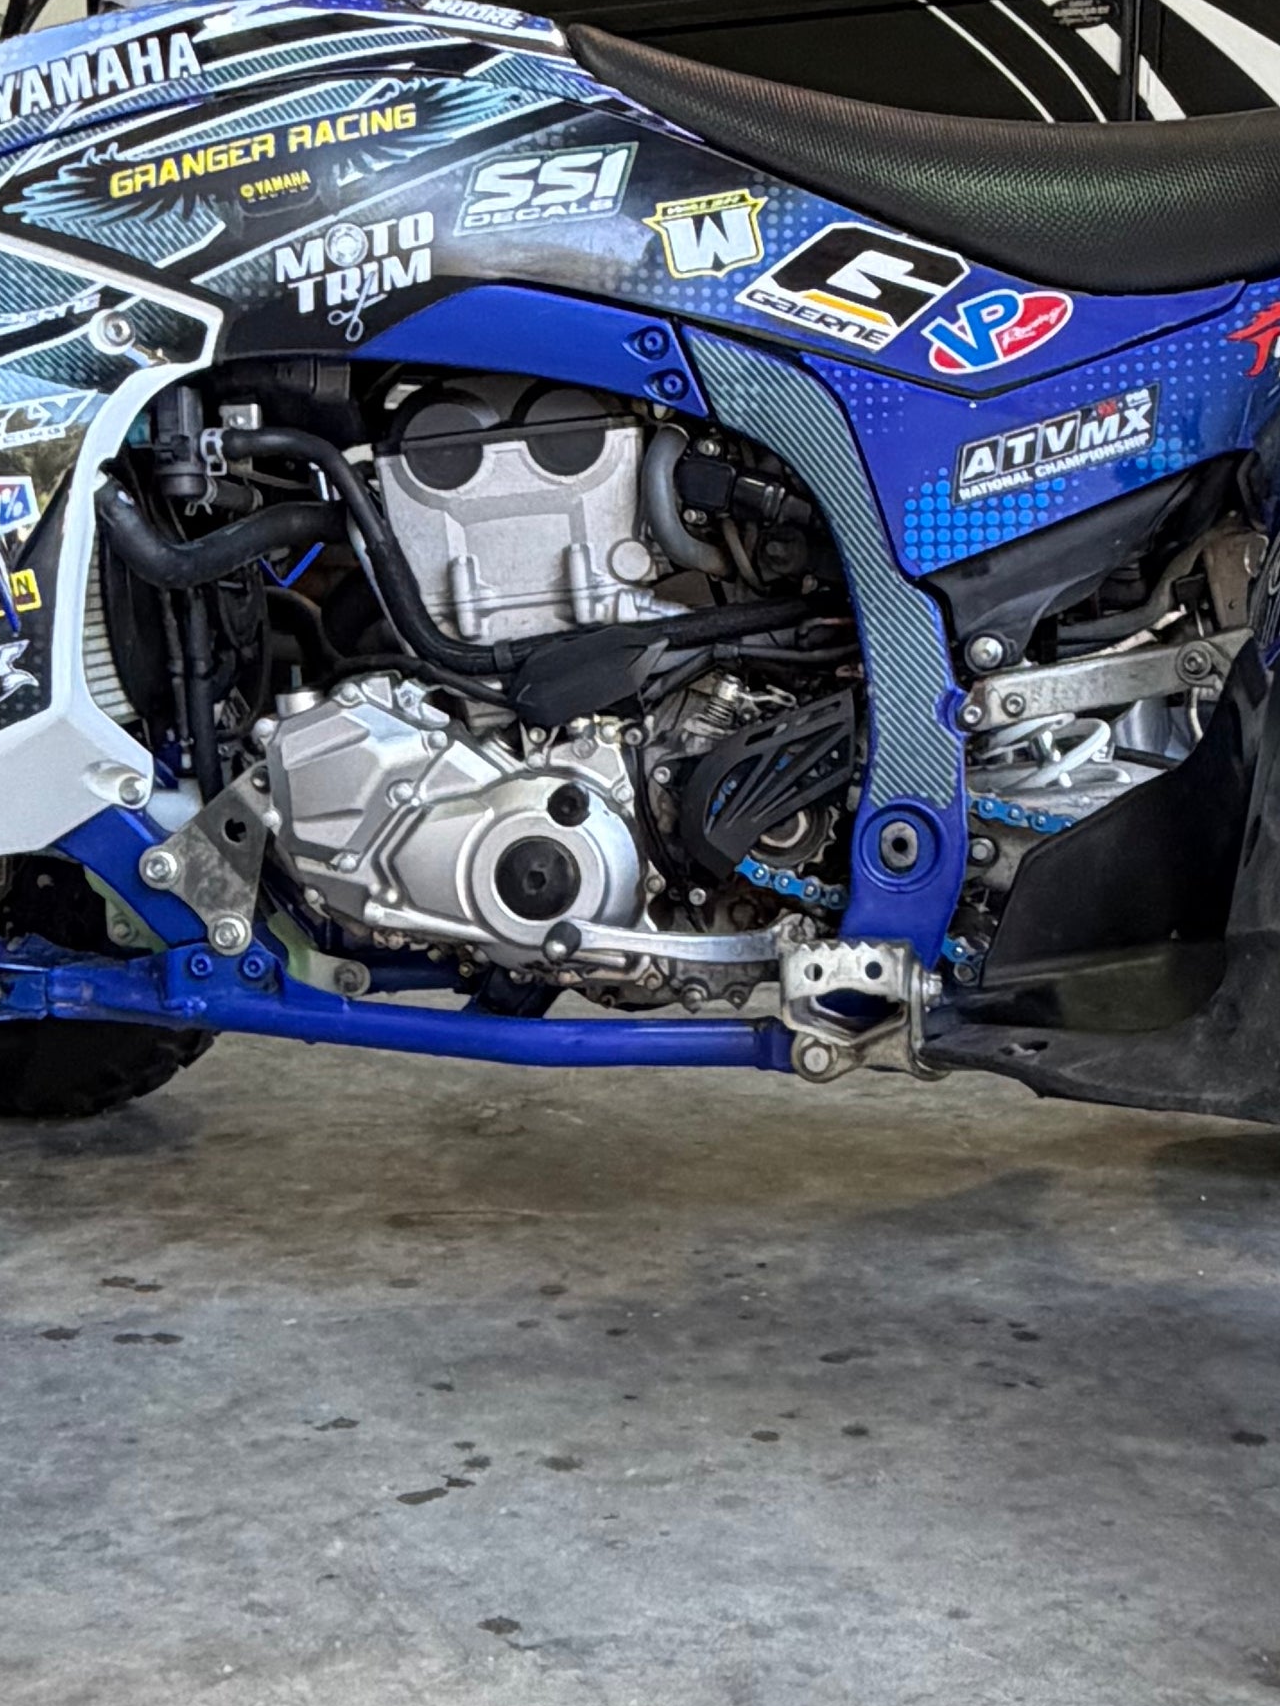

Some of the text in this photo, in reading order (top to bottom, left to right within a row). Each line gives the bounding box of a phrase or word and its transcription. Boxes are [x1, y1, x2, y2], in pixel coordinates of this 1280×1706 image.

[109, 103, 417, 199] GRANGER RACING
[254, 169, 312, 195] YAMAHA
[468, 149, 629, 214] SSI
[464, 197, 613, 228] DECALS
[275, 211, 434, 283] MOTO
[288, 249, 432, 314] TRIM
[922, 292, 1022, 369] VP
[959, 432, 1150, 500] NATIONAL CHAMPIONSHIP
[964, 403, 1151, 479] ATVMX
